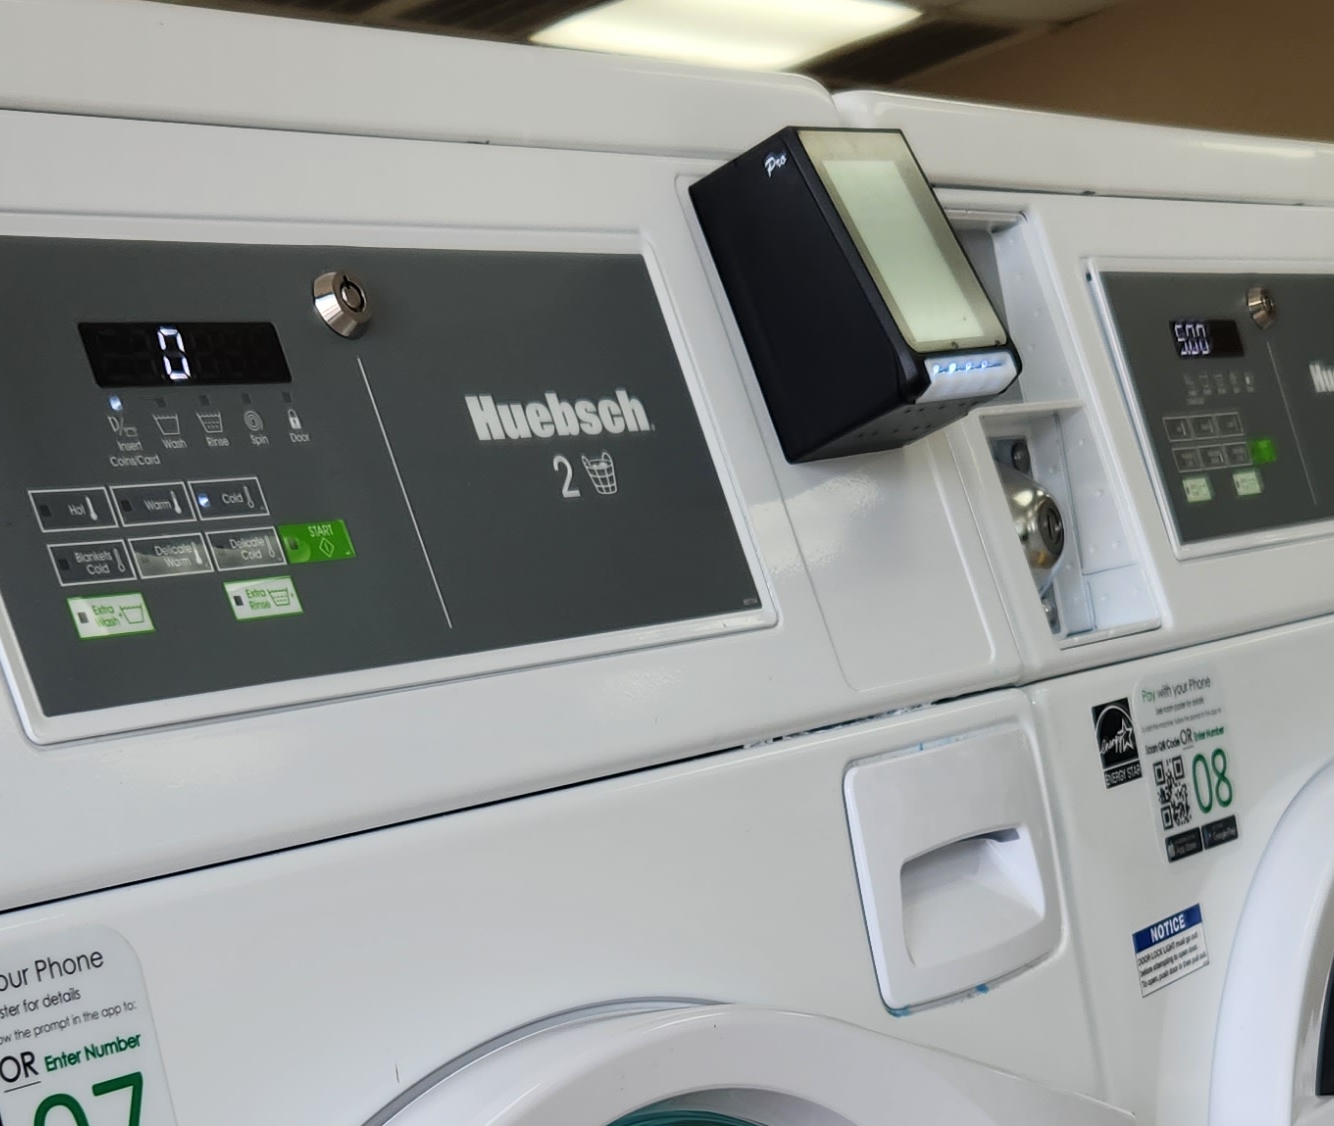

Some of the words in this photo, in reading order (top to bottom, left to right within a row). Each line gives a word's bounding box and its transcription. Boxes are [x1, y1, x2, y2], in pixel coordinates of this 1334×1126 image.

[157, 327, 191, 381] 0
[464, 386, 652, 441] Huebsch
[162, 438, 188, 449] Wash
[205, 437, 230, 448] Rinse
[249, 434, 270, 446] Spin
[289, 432, 311, 443] Door
[117, 441, 143, 452] Insert
[553, 455, 581, 499] 2
[143, 500, 173, 511] Warm
[221, 493, 244, 505] Cold
[307, 524, 334, 538] START
[154, 543, 193, 557] Delicate
[228, 536, 266, 550] Delicate
[73, 550, 113, 564] Blankets
[162, 556, 192, 568] Warm
[240, 549, 263, 561] Cold
[85, 563, 111, 576] Cold
[244, 588, 267, 600] Extra
[91, 604, 115, 616] Extra
[248, 600, 272, 611] Rinse
[1188, 676, 1211, 693] Phone
[1179, 728, 1193, 746] OR
[1191, 747, 1233, 814] 08
[1149, 914, 1186, 943] NOTICE
[34, 951, 105, 982] Phone
[22, 998, 40, 1014] for
[42, 987, 82, 1009] details
[13, 1028, 32, 1042] the
[33, 1016, 71, 1038] prompt
[71, 1013, 82, 1026] in
[82, 1009, 100, 1023] the
[101, 1004, 122, 1019] app
[123, 1000, 137, 1012] to:
[44, 1051, 81, 1073] Enter
[83, 1033, 142, 1062] Number
